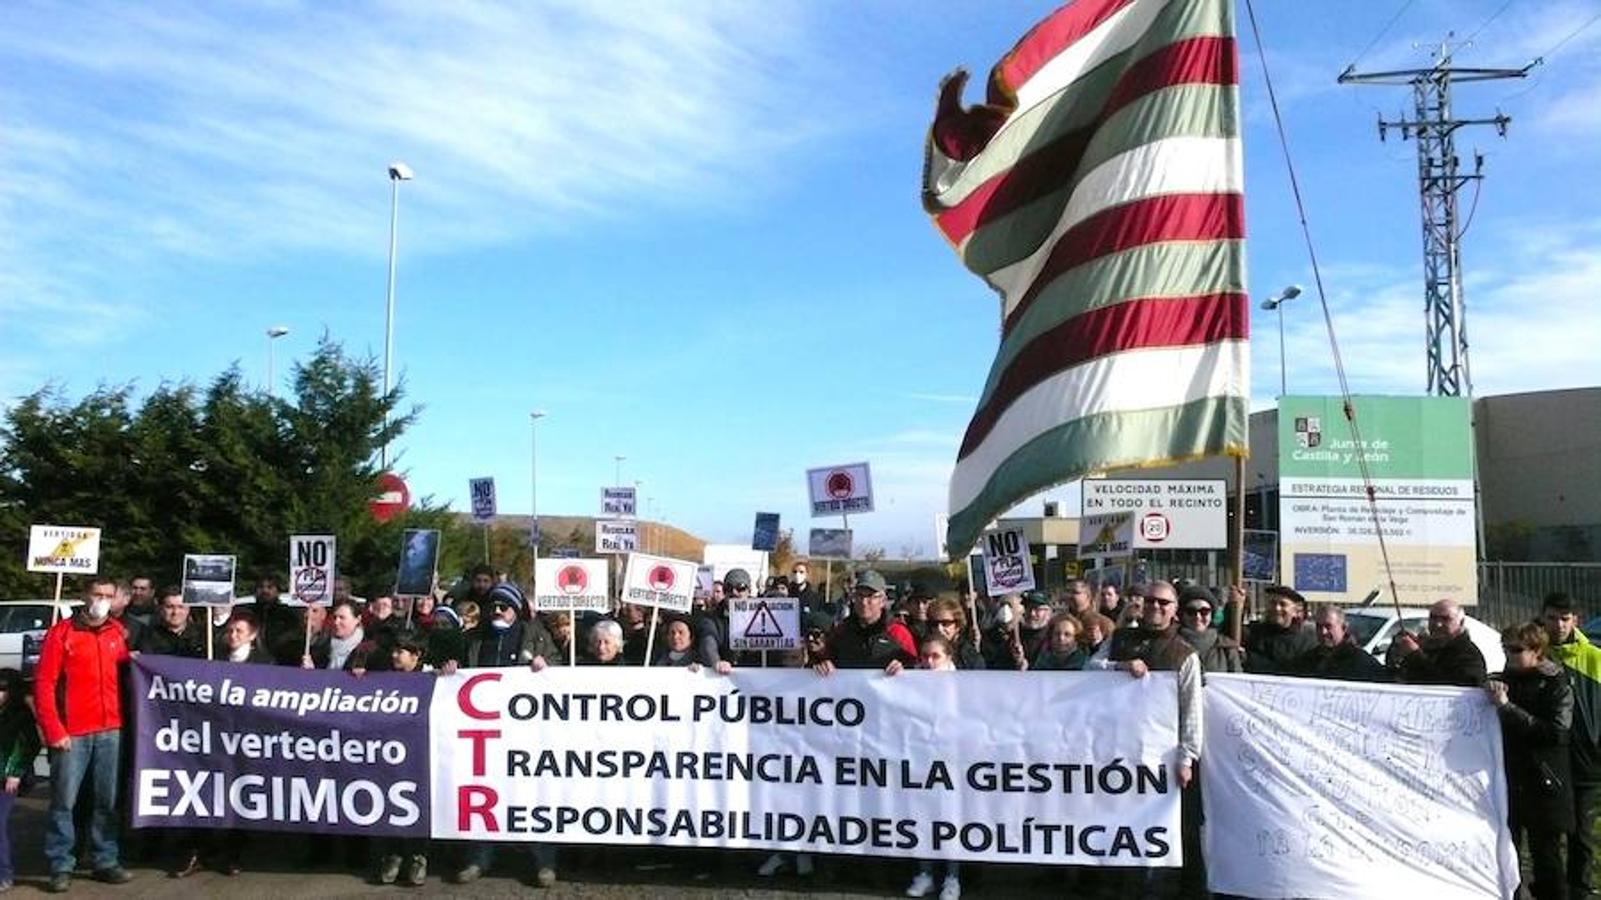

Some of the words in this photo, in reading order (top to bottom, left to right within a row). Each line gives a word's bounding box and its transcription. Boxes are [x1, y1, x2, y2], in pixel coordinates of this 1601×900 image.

[1292, 450, 1340, 461] Castilla
[1343, 453, 1352, 464] y
[1087, 499, 1102, 508] EN
[1110, 499, 1143, 508] TODO
[1150, 499, 1163, 508] EL
[1170, 499, 1222, 508] RECINTO
[1095, 485, 1161, 494] VELOCIDAD
[1291, 484, 1347, 494] ESTRATEGIA
[1398, 486, 1411, 495] DE
[1412, 486, 1458, 496] RESIDUOS
[298, 541, 327, 567] NO
[988, 531, 1020, 557] NO
[148, 675, 212, 704] Ante
[220, 680, 246, 706] la
[252, 687, 419, 717] ampliación
[693, 688, 865, 726] PÚBLICO
[155, 719, 211, 754] del
[220, 730, 407, 765] vertedero
[836, 757, 887, 787] EN
[901, 759, 954, 790] LA
[966, 758, 1168, 794] GESTIÓN
[138, 769, 421, 828] EXIGIMOS
[932, 818, 1170, 859] POLÍTICAS
